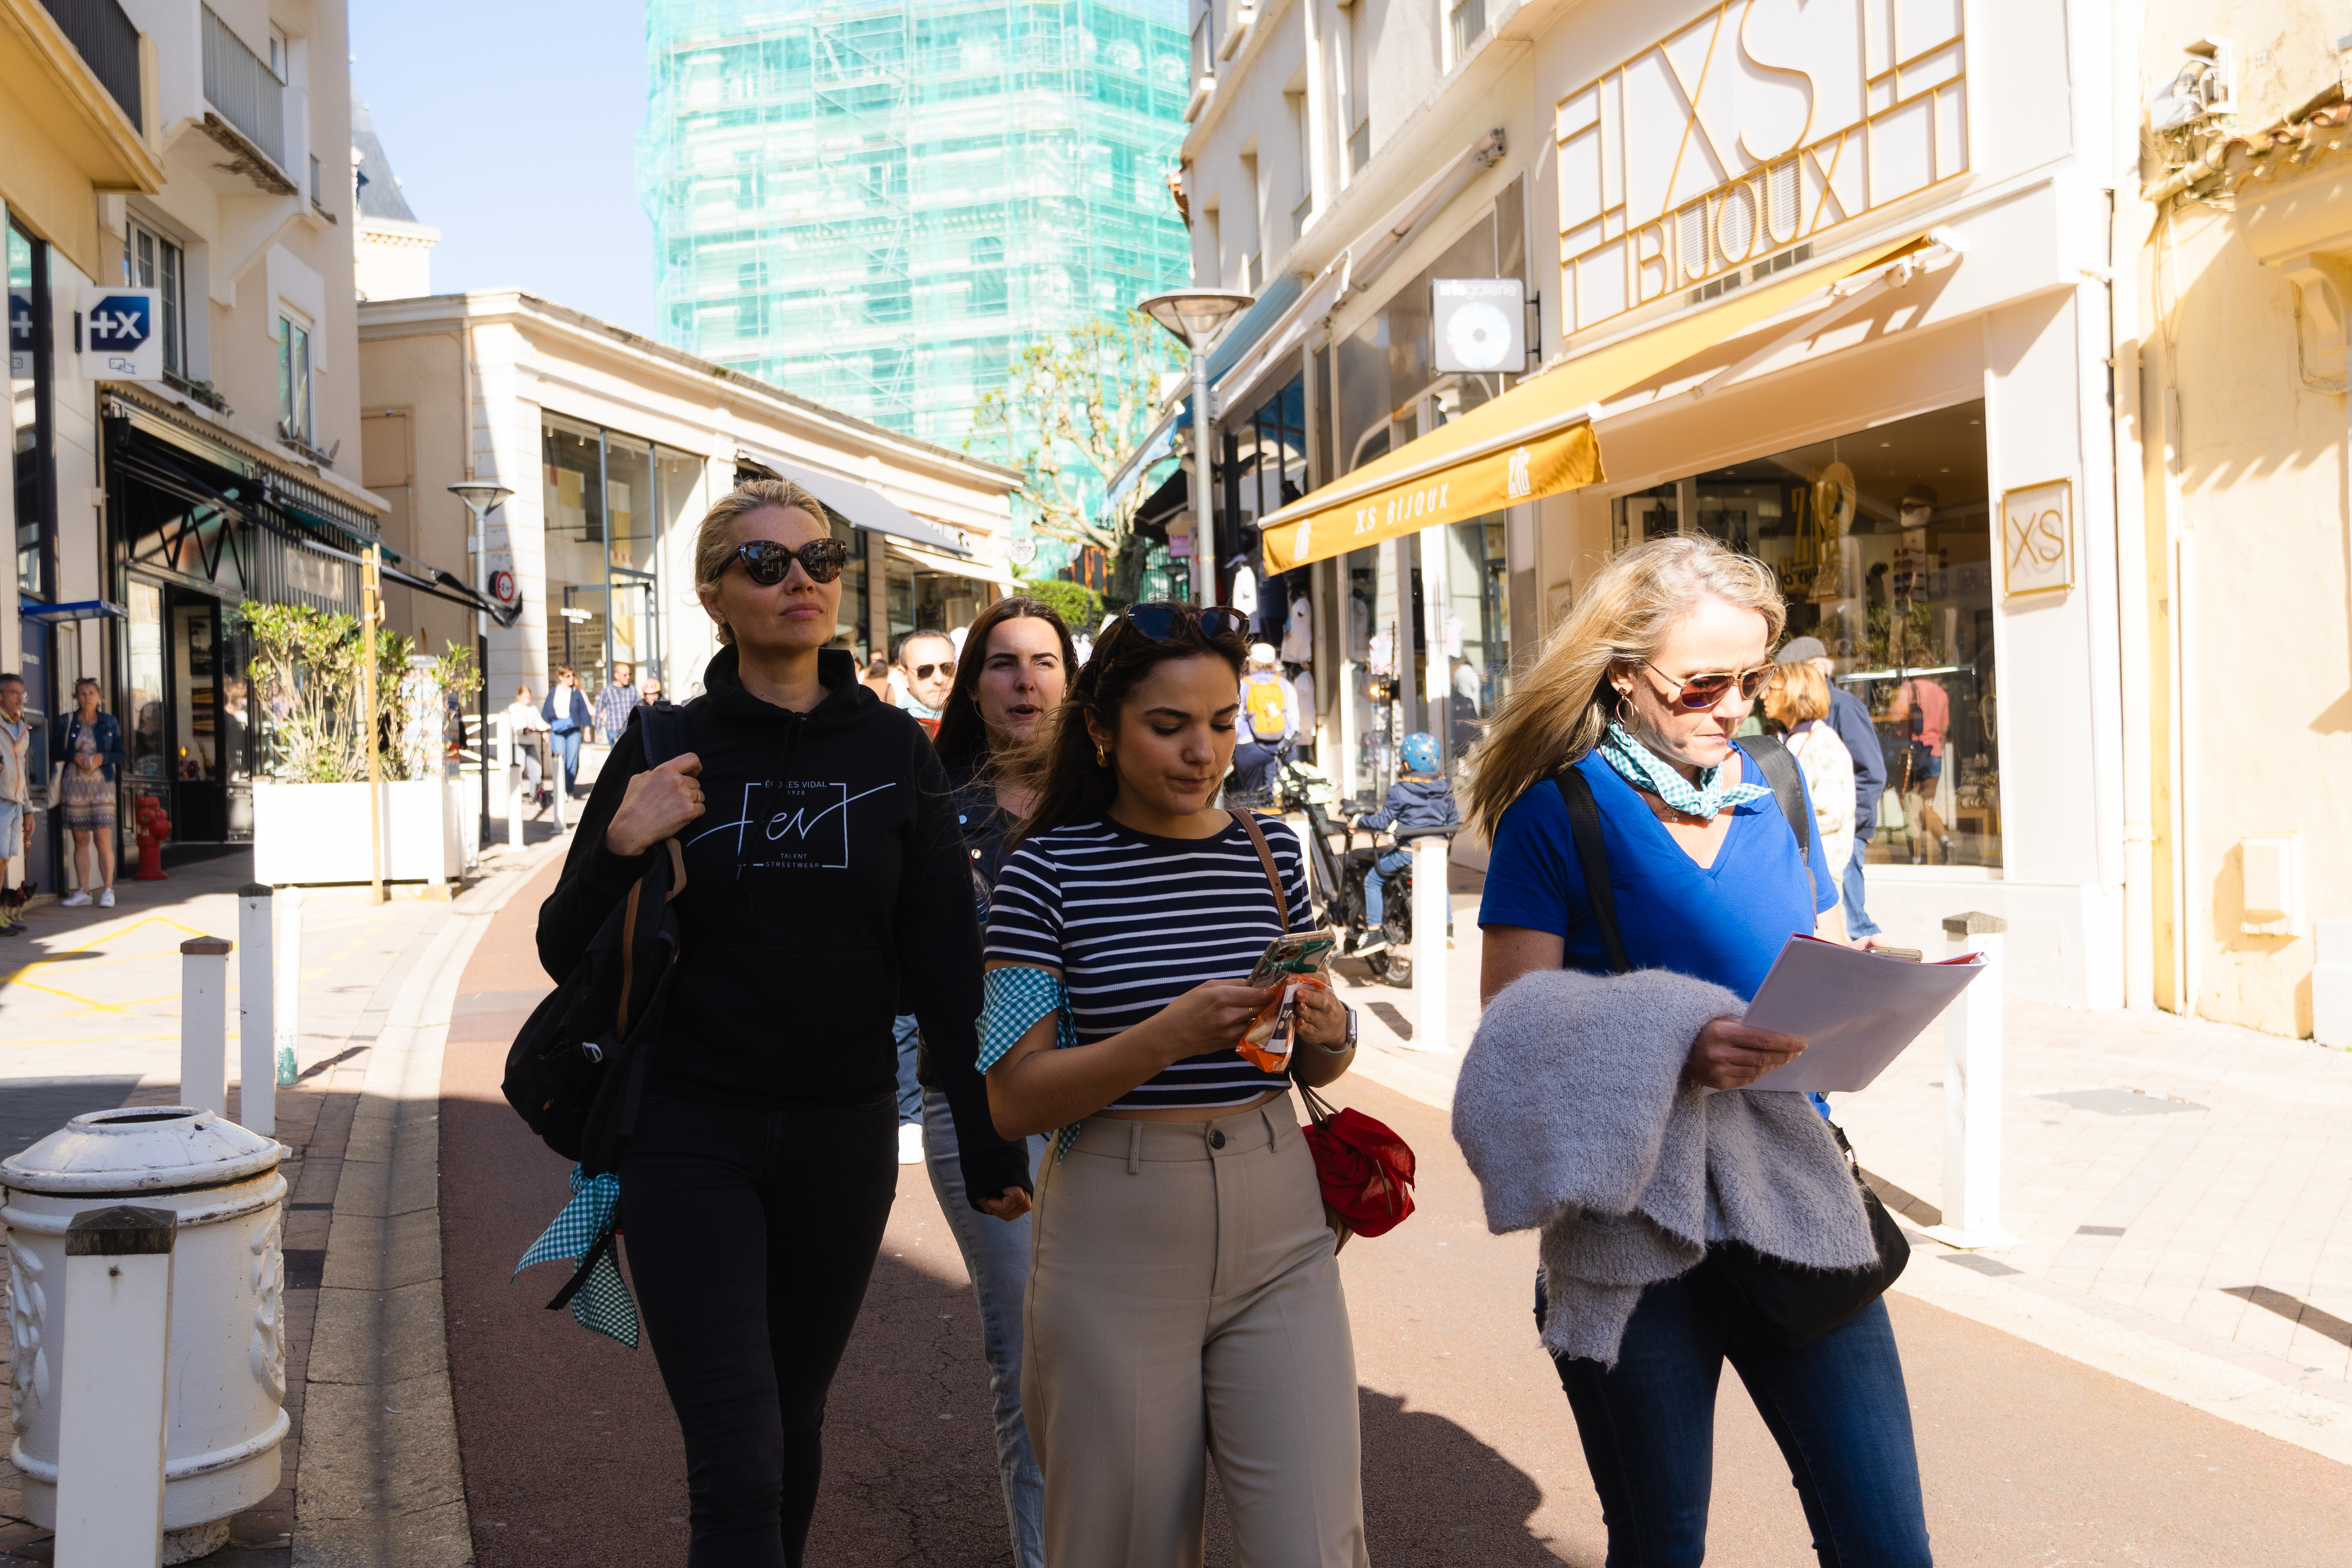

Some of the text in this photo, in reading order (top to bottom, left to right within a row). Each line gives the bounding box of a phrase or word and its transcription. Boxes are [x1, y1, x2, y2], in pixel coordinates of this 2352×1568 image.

[1660, 0, 1814, 213] XS
[1639, 132, 1848, 303] BIJOUX
[1354, 483, 1449, 535] XS BIJOUX
[2012, 509, 2064, 569] XS
